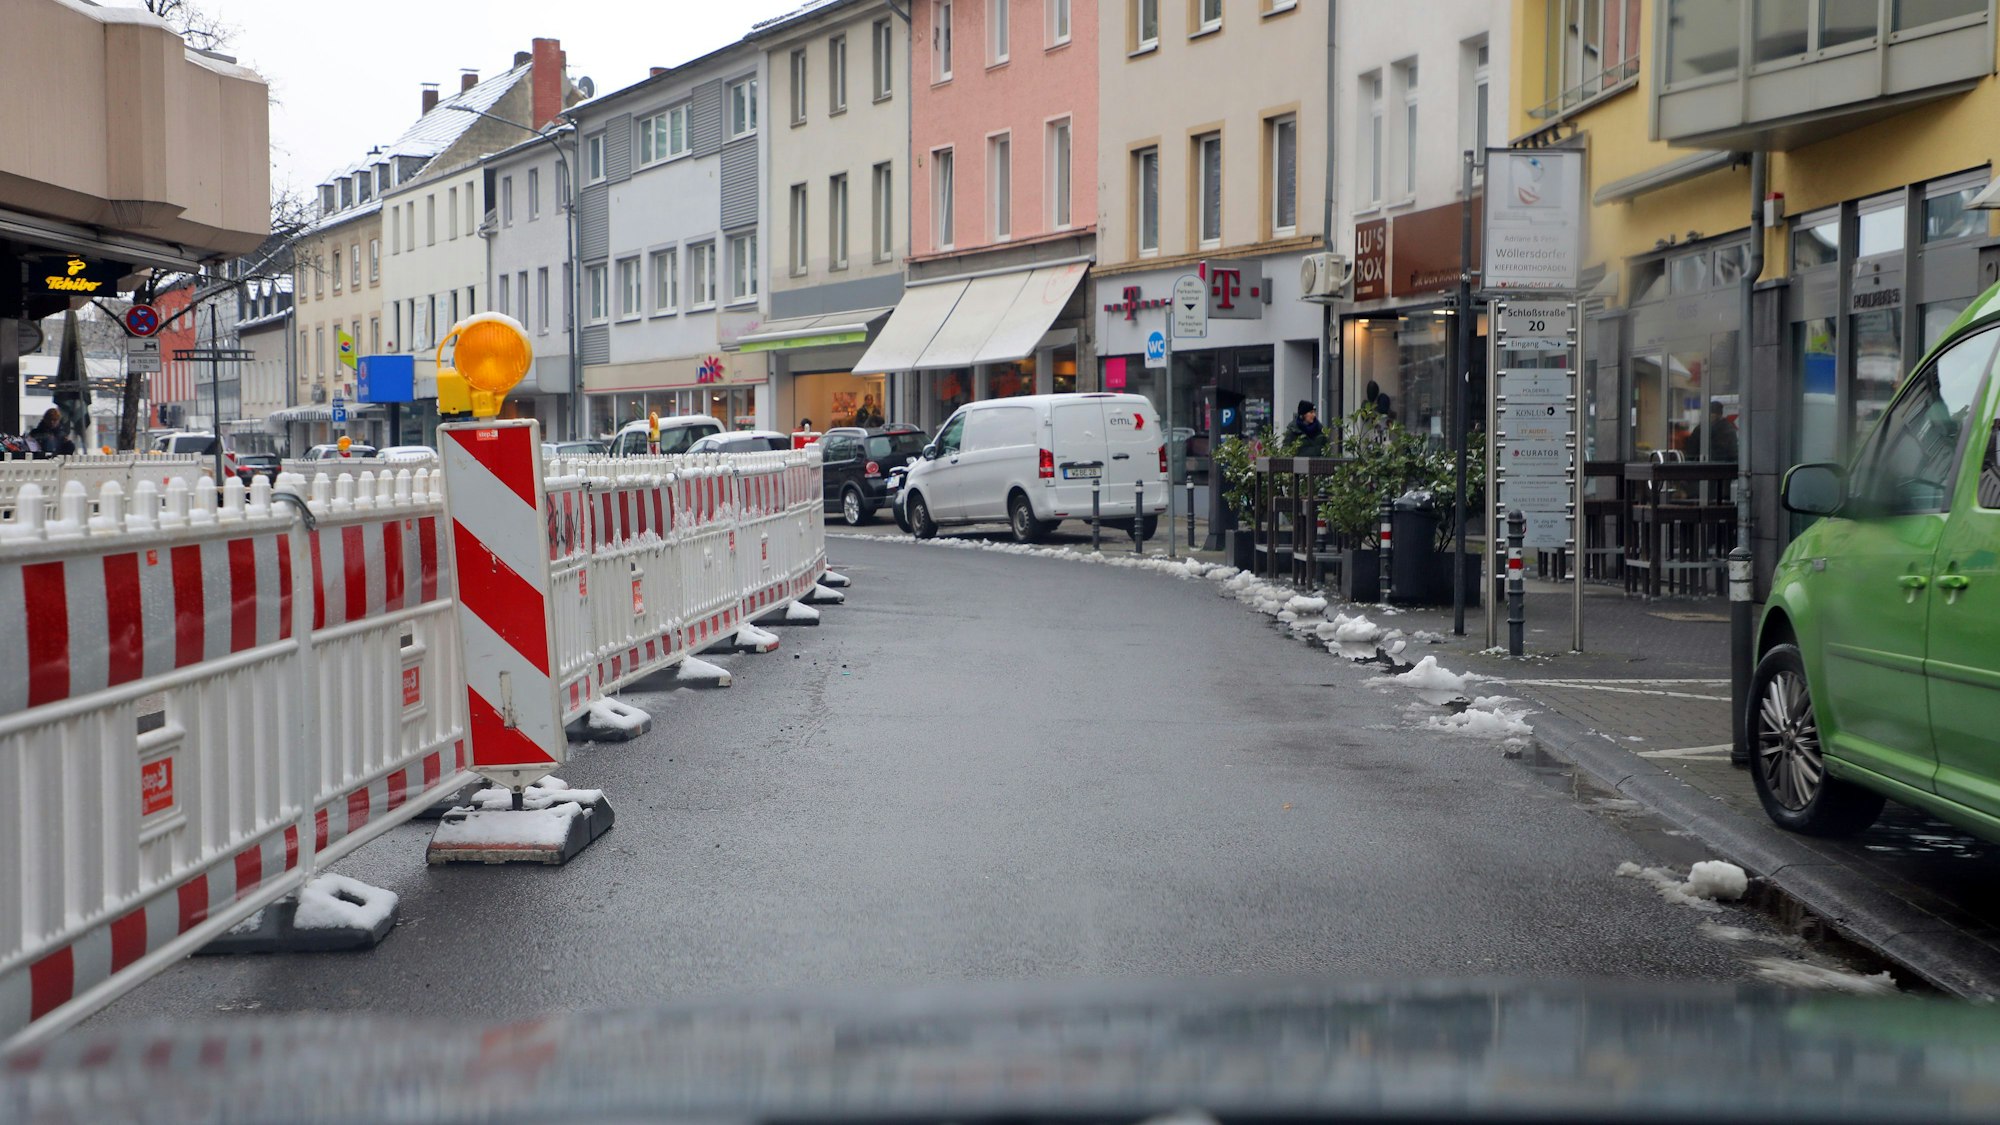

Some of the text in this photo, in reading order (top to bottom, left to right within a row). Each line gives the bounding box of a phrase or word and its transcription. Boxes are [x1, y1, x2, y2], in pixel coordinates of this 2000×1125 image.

[1357, 227, 1384, 255] LU'S
[1495, 248, 1567, 259] Wöllersdorfer
[1356, 256, 1383, 283] BOX
[45, 276, 103, 292] Tchibo
[1508, 308, 1566, 318] Schloßstraße
[1528, 320, 1545, 332] 20
[1148, 340, 1165, 354] WC
[1511, 340, 1539, 348] Eingang
[335, 409, 344, 421] P
[1222, 408, 1231, 423] P
[1516, 409, 1546, 417] KONLUS
[1520, 449, 1559, 457] CURATOR
